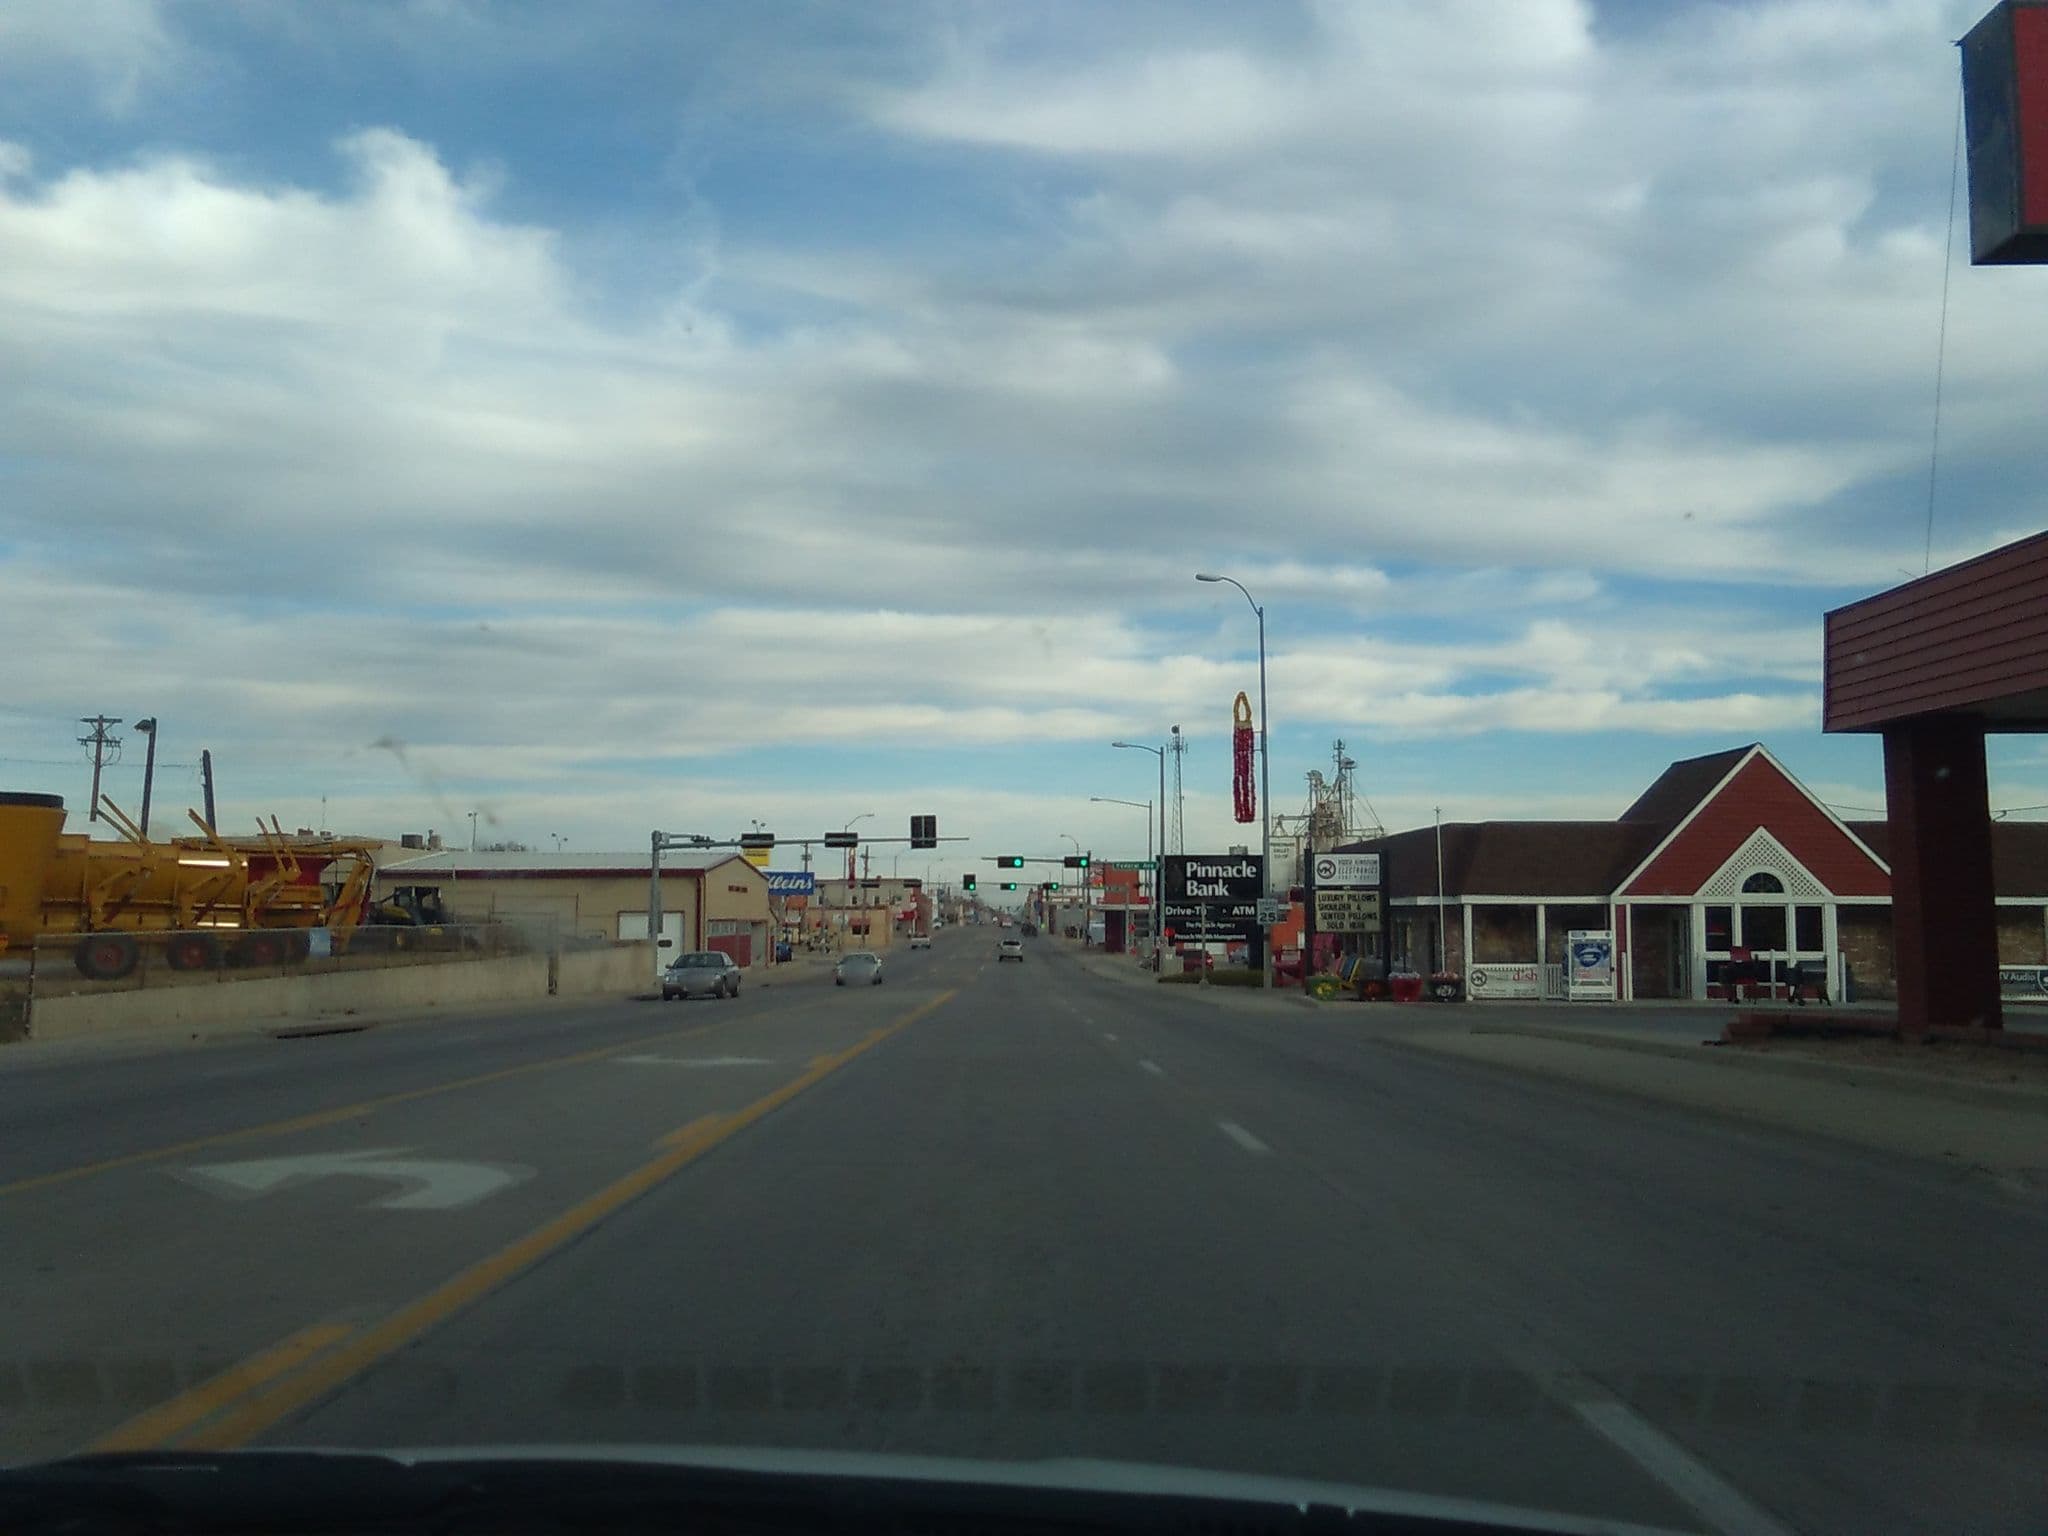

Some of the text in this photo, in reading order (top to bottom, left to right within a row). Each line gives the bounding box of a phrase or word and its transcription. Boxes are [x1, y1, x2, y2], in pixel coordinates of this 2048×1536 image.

[1186, 861, 1257, 878] Pinnacle
[1186, 879, 1229, 897] Bank
[1232, 906, 1255, 915] ATM
[1259, 912, 1276, 922] 25
[2010, 971, 2036, 981] Audio
